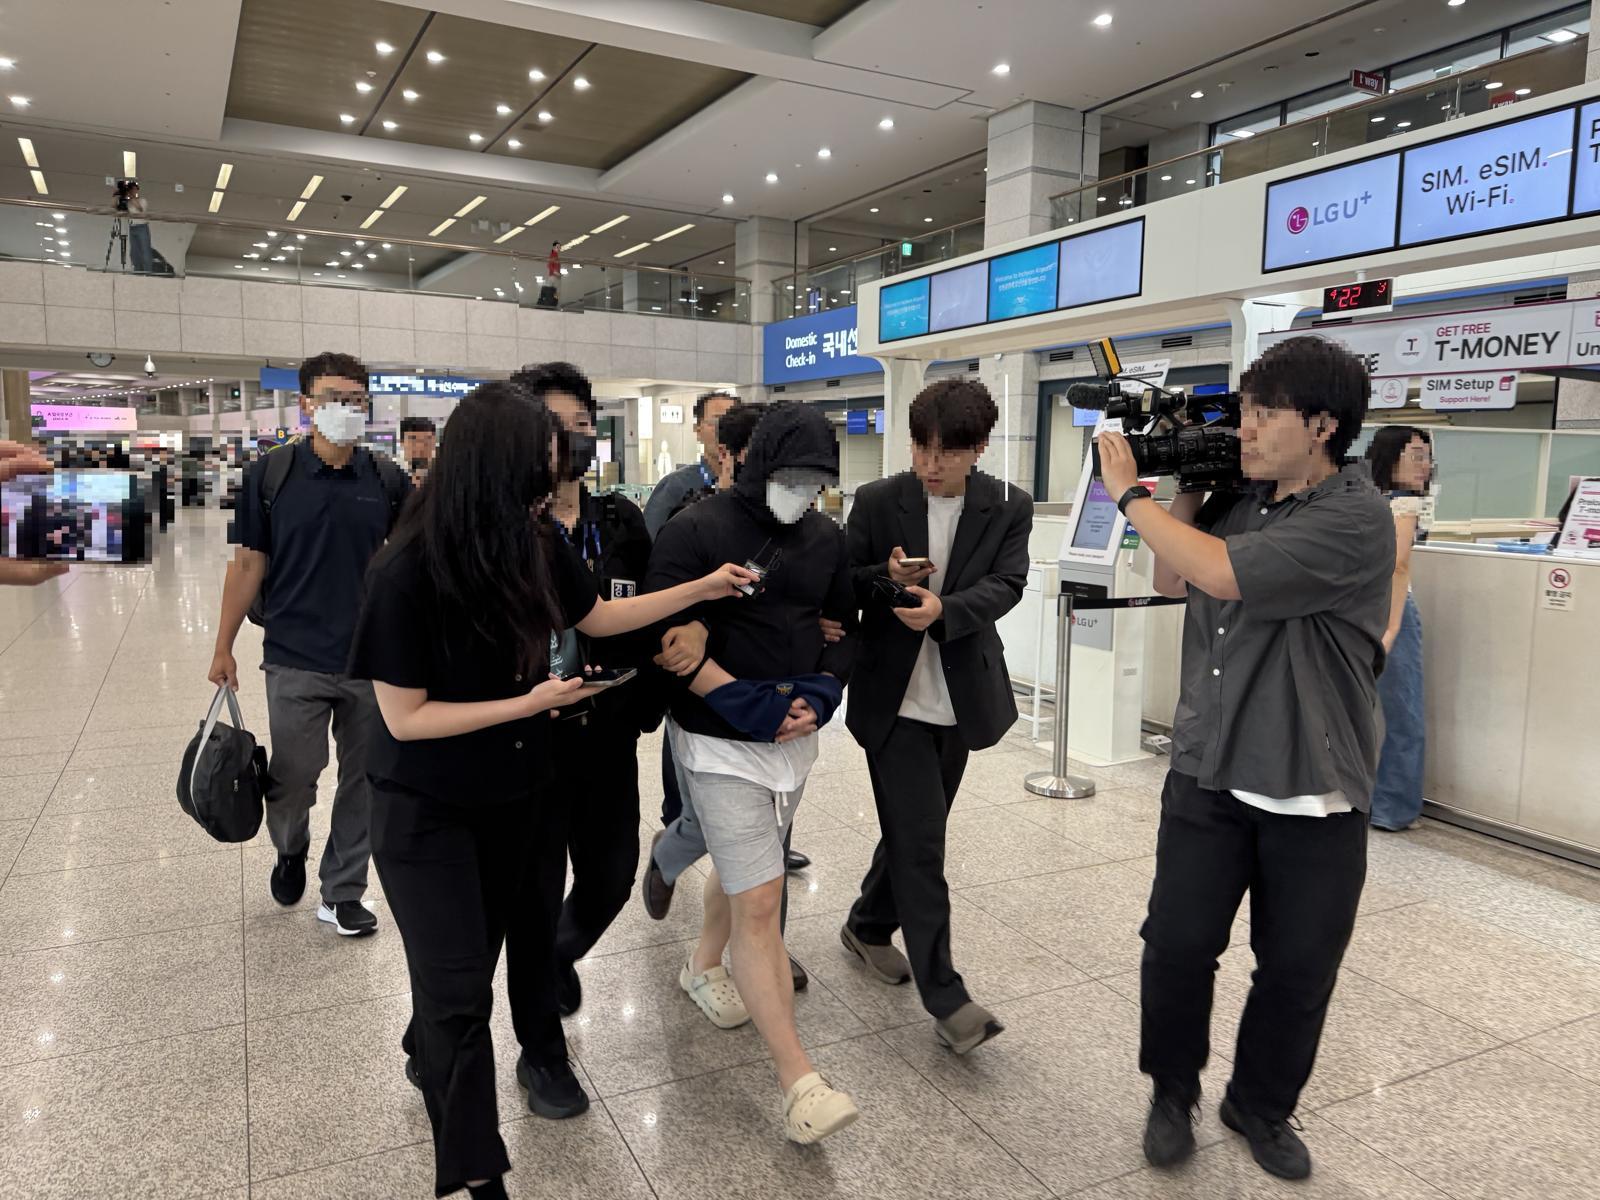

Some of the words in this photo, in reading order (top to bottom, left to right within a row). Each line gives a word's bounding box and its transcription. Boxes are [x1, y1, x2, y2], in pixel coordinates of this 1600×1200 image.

[1421, 165, 1468, 193] SIM.
[1479, 147, 1548, 180] eSIM.
[1446, 183, 1515, 215] Wi-Fi.
[1436, 325, 1460, 337] GET
[1461, 322, 1492, 335] FREE
[785, 331, 818, 350] Domestic
[1434, 330, 1561, 361] T-MONEY
[785, 351, 816, 369] Check-in
[1426, 379, 1451, 391] SIM
[1454, 378, 1495, 393] Setup
[1439, 395, 1469, 405] Support
